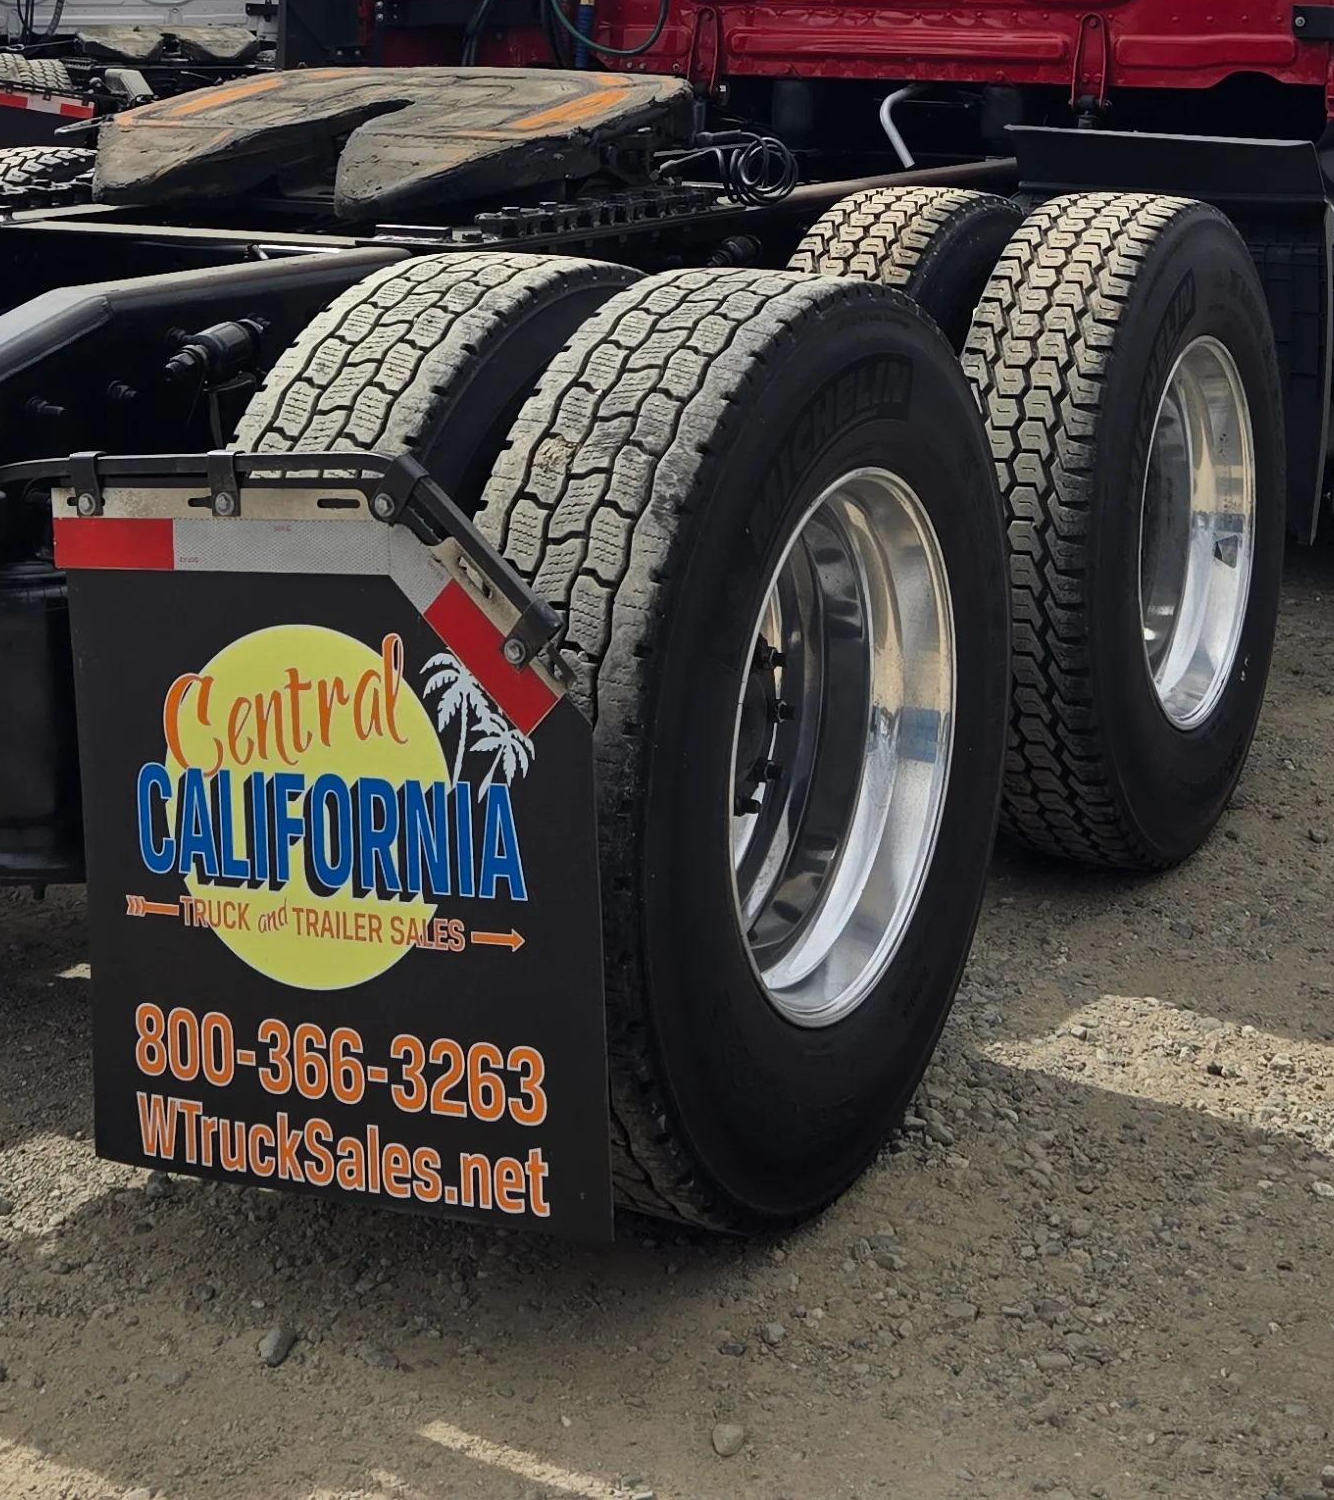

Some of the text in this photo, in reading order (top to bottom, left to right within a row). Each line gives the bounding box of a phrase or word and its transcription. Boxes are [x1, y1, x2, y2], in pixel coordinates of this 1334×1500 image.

[749, 360, 911, 556] MICHELIN
[163, 632, 409, 777] Central
[137, 761, 529, 901] CALIFORNIA
[179, 895, 466, 952] TRUCK and TRAILER SALES
[134, 1001, 548, 1128] 800-366-3263
[135, 1090, 550, 1218] WTruckSales.net
